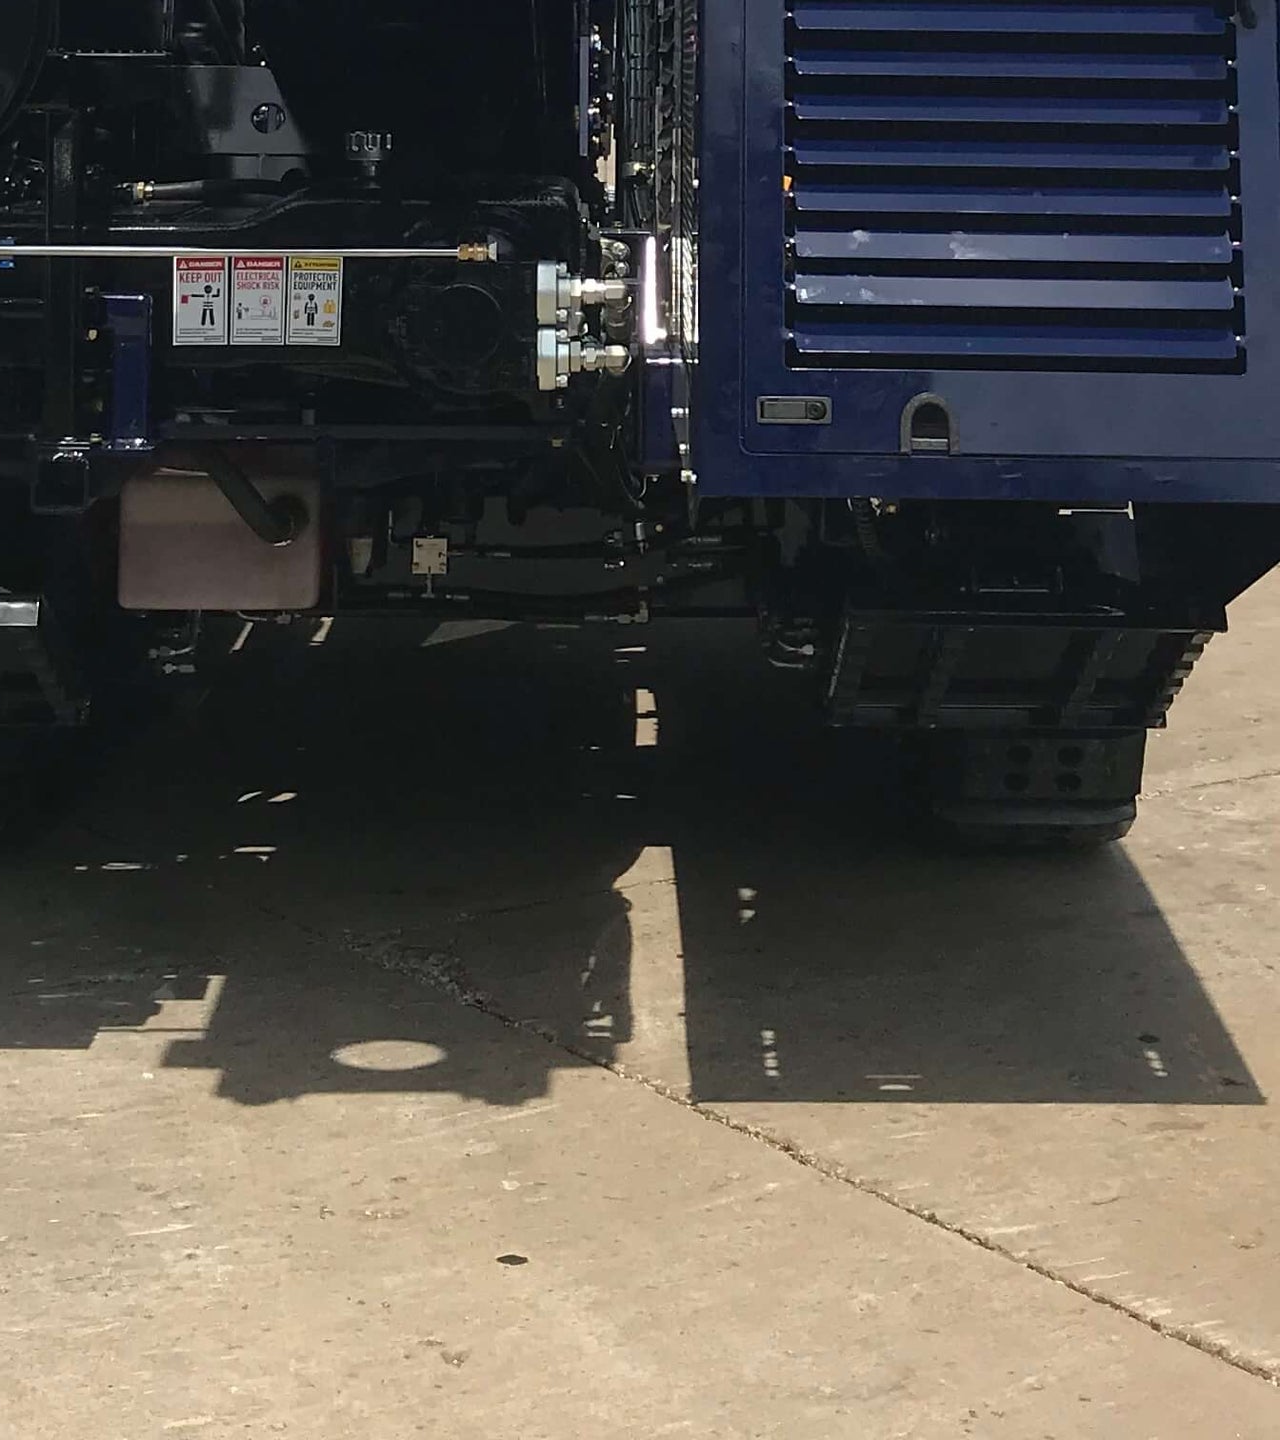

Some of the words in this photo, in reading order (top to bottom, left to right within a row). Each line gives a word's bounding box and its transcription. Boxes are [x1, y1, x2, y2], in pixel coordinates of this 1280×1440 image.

[179, 272, 202, 283] KEEP
[204, 272, 222, 283] OUT
[236, 272, 279, 281] ELECTRICAL
[293, 272, 338, 282] PROTECTIVE
[236, 281, 261, 290] SHOCK
[262, 281, 280, 290] RISK
[293, 281, 337, 291] EQUIPMENT
